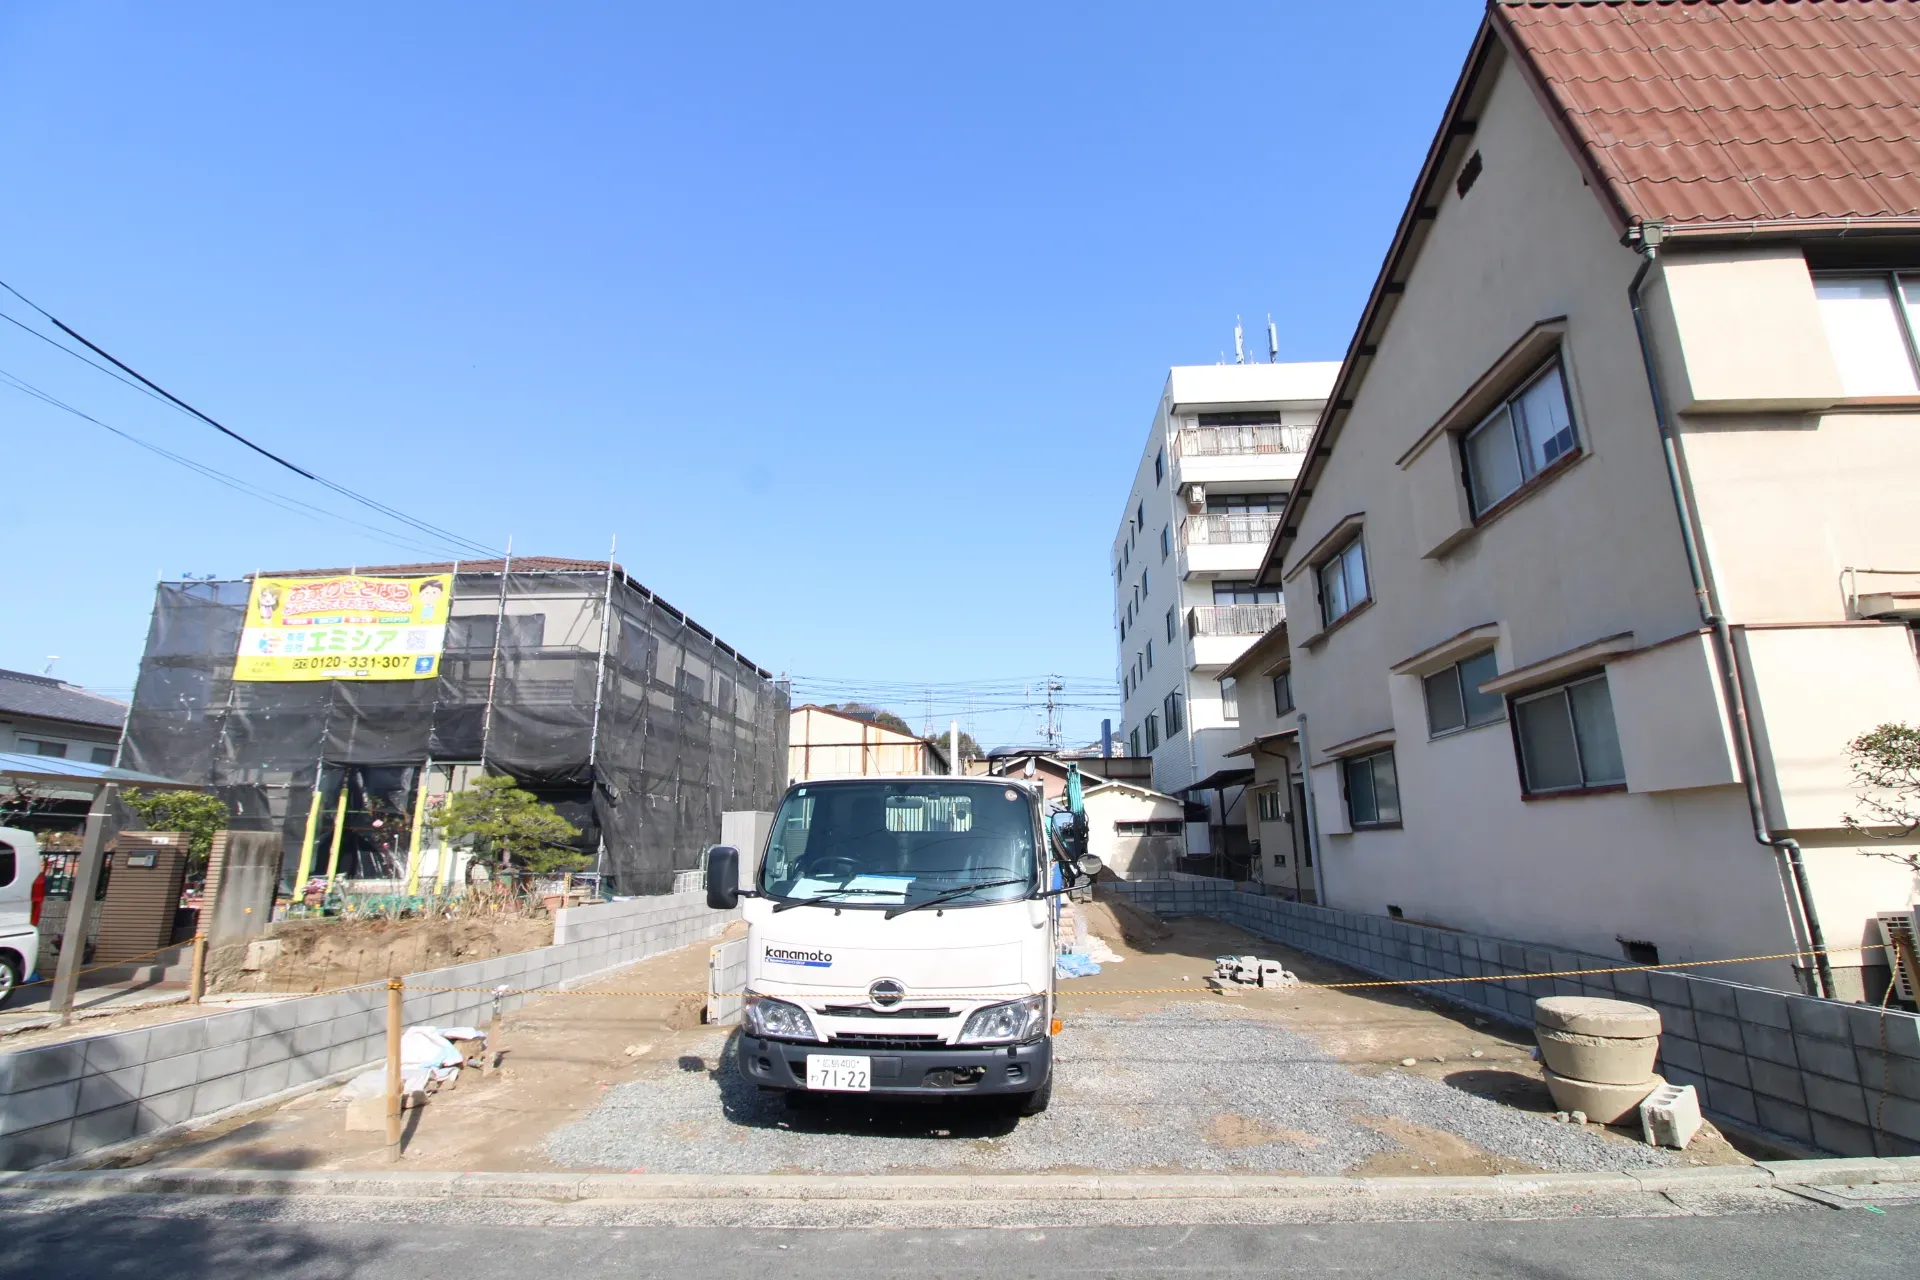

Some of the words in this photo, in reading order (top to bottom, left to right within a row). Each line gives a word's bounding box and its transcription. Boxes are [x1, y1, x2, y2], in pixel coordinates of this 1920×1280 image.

[289, 580, 412, 602] お家のことなら
[307, 629, 398, 652] エミシア
[310, 656, 410, 669] 0120-331-307
[765, 945, 833, 962] kanamoto
[821, 1069, 867, 1088] 71-22
